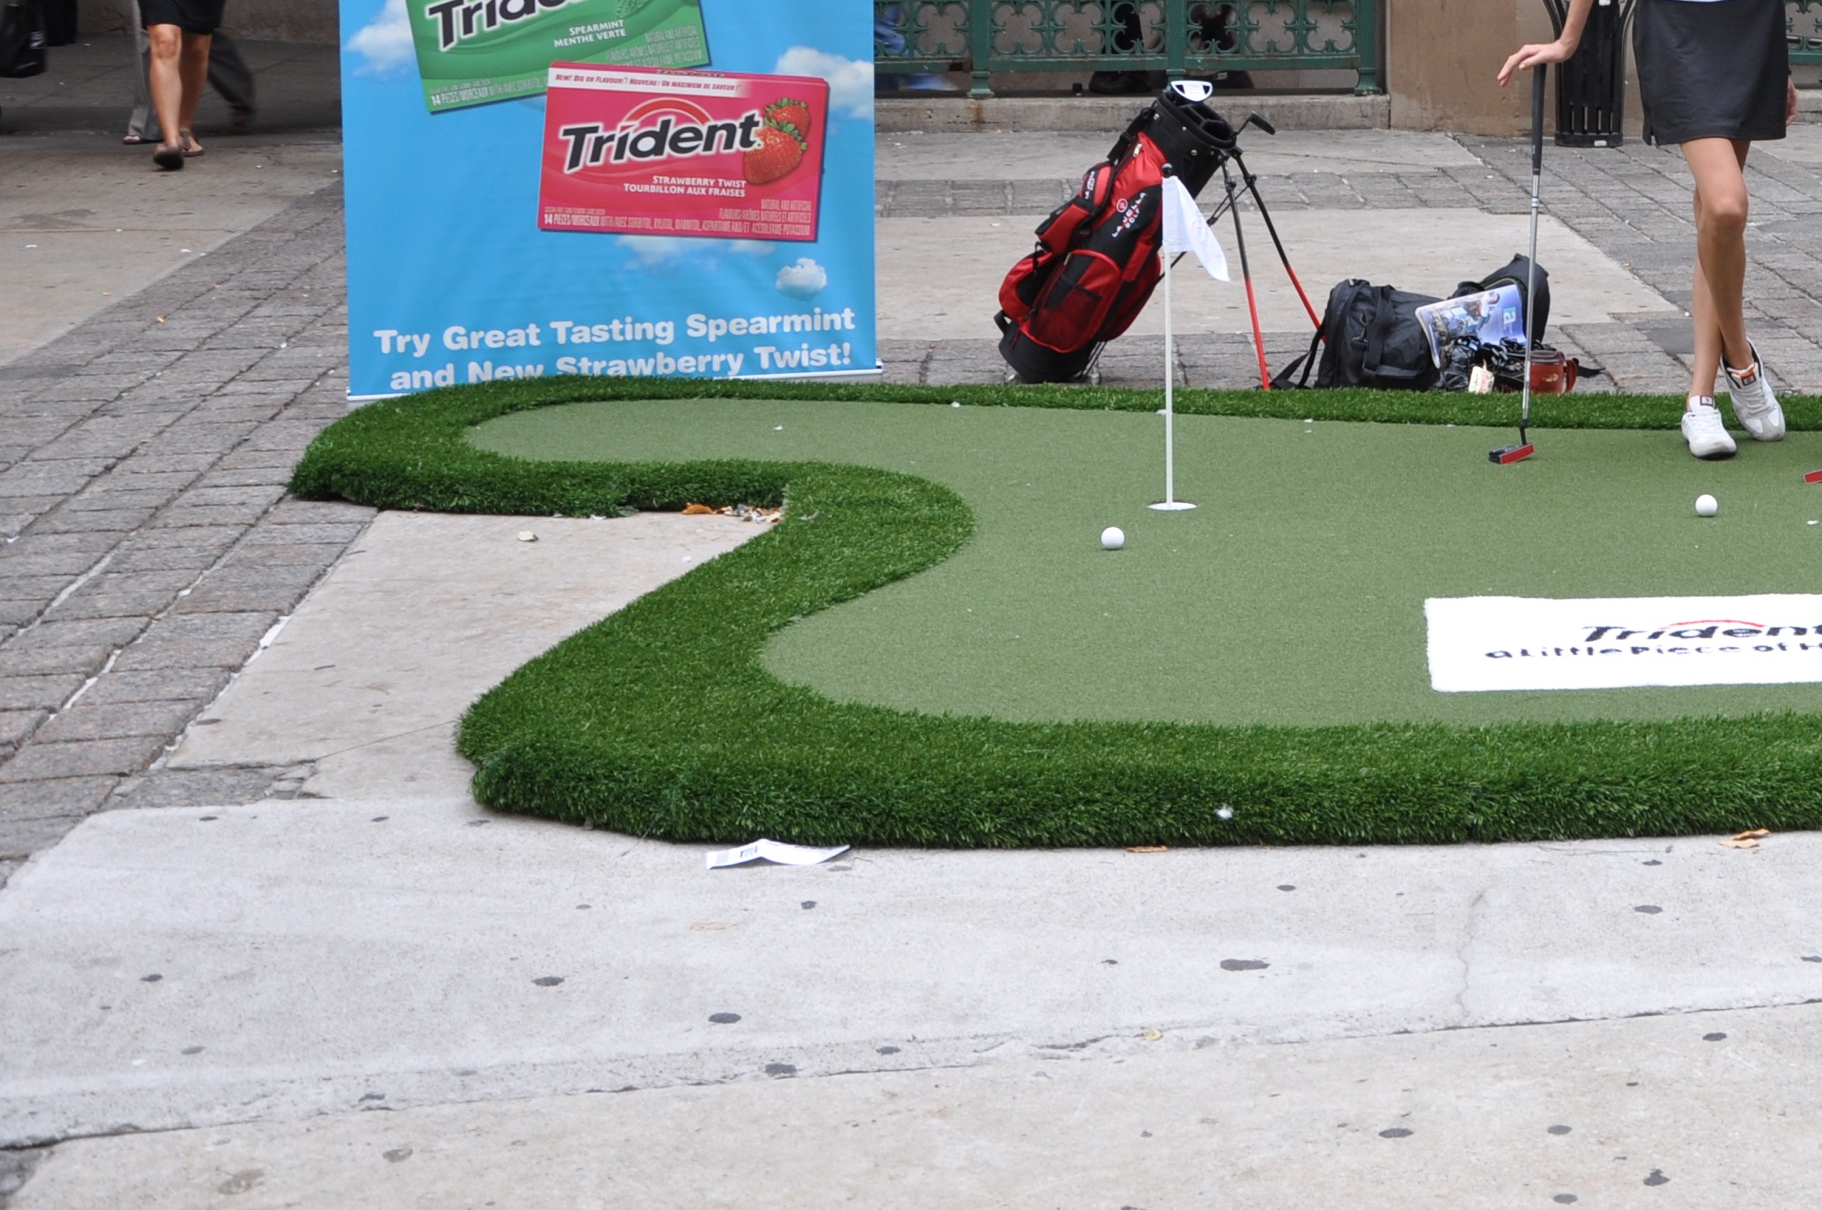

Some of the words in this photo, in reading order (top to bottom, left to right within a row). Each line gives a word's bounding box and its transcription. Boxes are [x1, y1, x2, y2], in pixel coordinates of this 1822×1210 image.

[554, 34, 595, 48] MENTHE
[597, 28, 627, 41] VERTE
[569, 19, 625, 37] SPEARMINT
[562, 112, 762, 172] Trident
[623, 183, 685, 194] TOURBILLON
[687, 187, 706, 196] AUX
[708, 187, 746, 198] FRAISES
[652, 175, 716, 188] STRAWBERRY
[717, 178, 747, 189] TWIST
[373, 328, 431, 358] Try
[442, 322, 542, 351] Great
[550, 316, 676, 346] Tasting
[686, 307, 855, 342] Spearmint
[390, 361, 455, 390] and
[468, 359, 544, 384] New
[556, 350, 745, 378] Strawberry
[753, 341, 852, 370] Twist!
